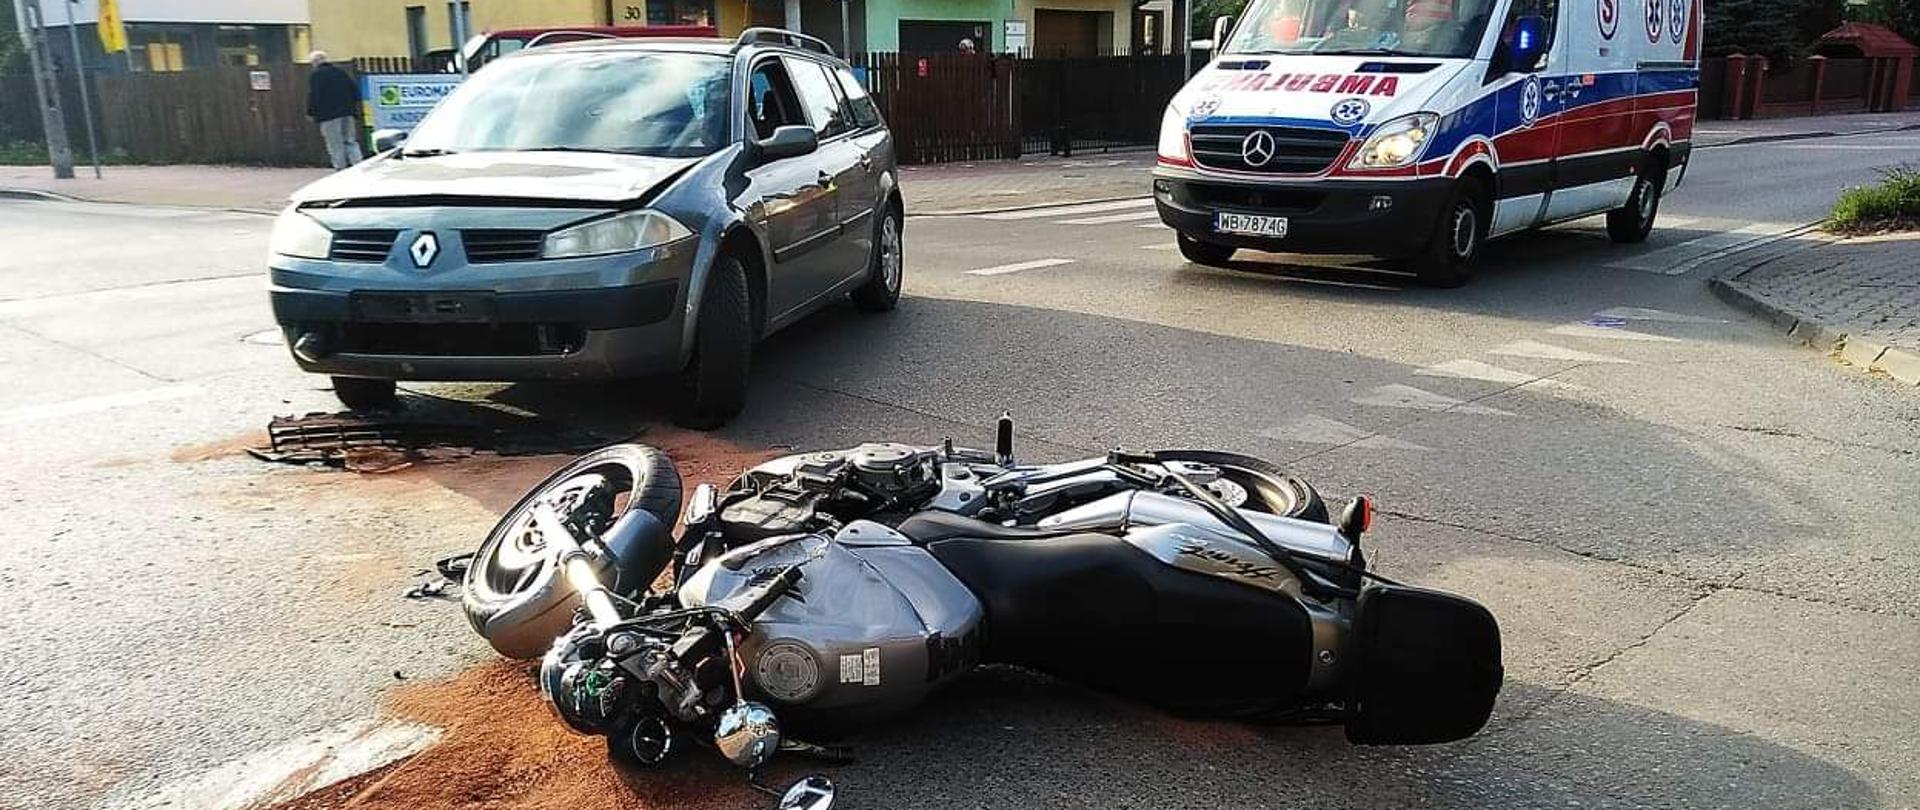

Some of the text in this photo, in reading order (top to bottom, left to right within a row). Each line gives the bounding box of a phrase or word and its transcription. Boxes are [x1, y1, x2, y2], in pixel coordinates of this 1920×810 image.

[624, 6, 640, 19] 30
[401, 85, 457, 98] EUROMA
[1221, 214, 1285, 234] WB 7874G
